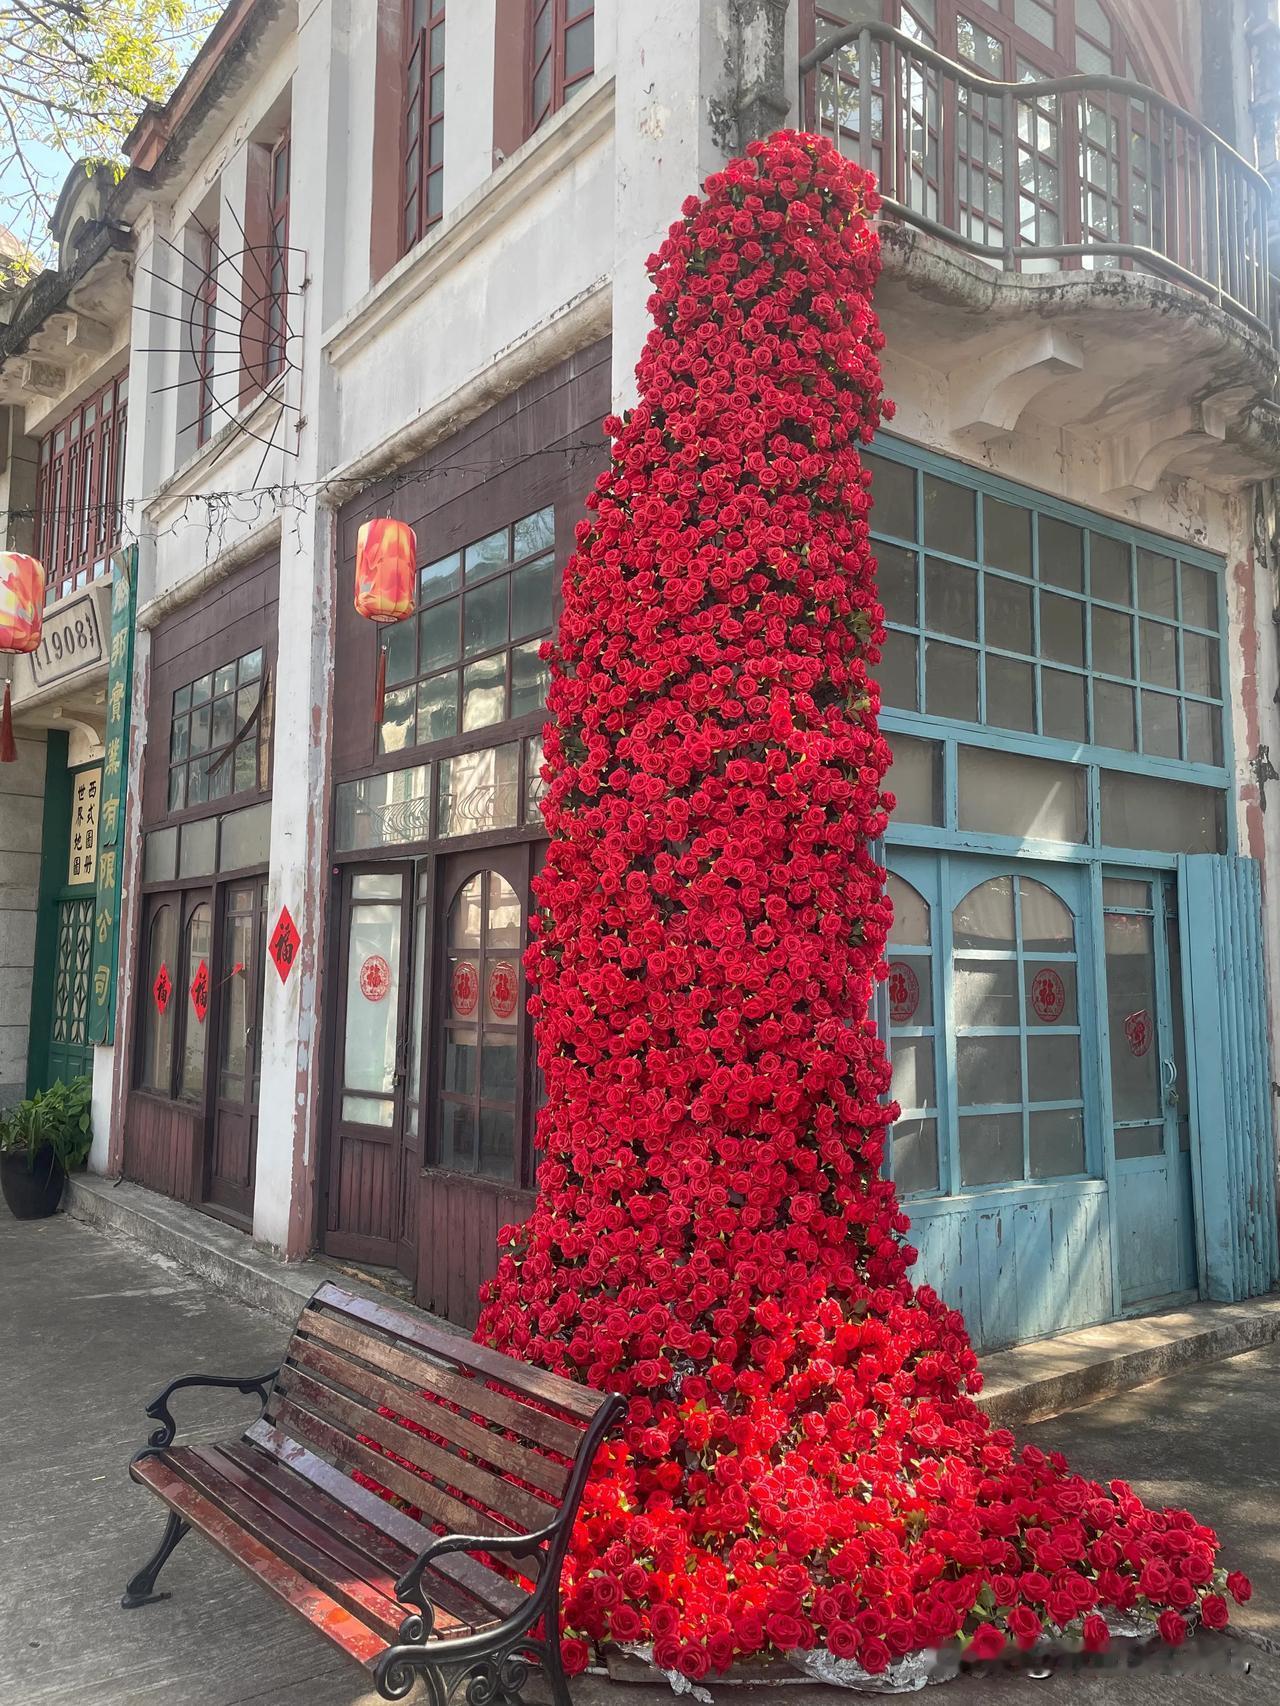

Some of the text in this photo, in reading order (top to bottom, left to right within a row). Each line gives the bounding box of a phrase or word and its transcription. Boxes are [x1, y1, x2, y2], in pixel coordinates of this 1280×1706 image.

[42, 620, 88, 665] 1908
[73, 784, 86, 876] 世界地圖
[274, 923, 293, 964] 福
[157, 974, 168, 1004] 福
[195, 973, 208, 1008] 福
